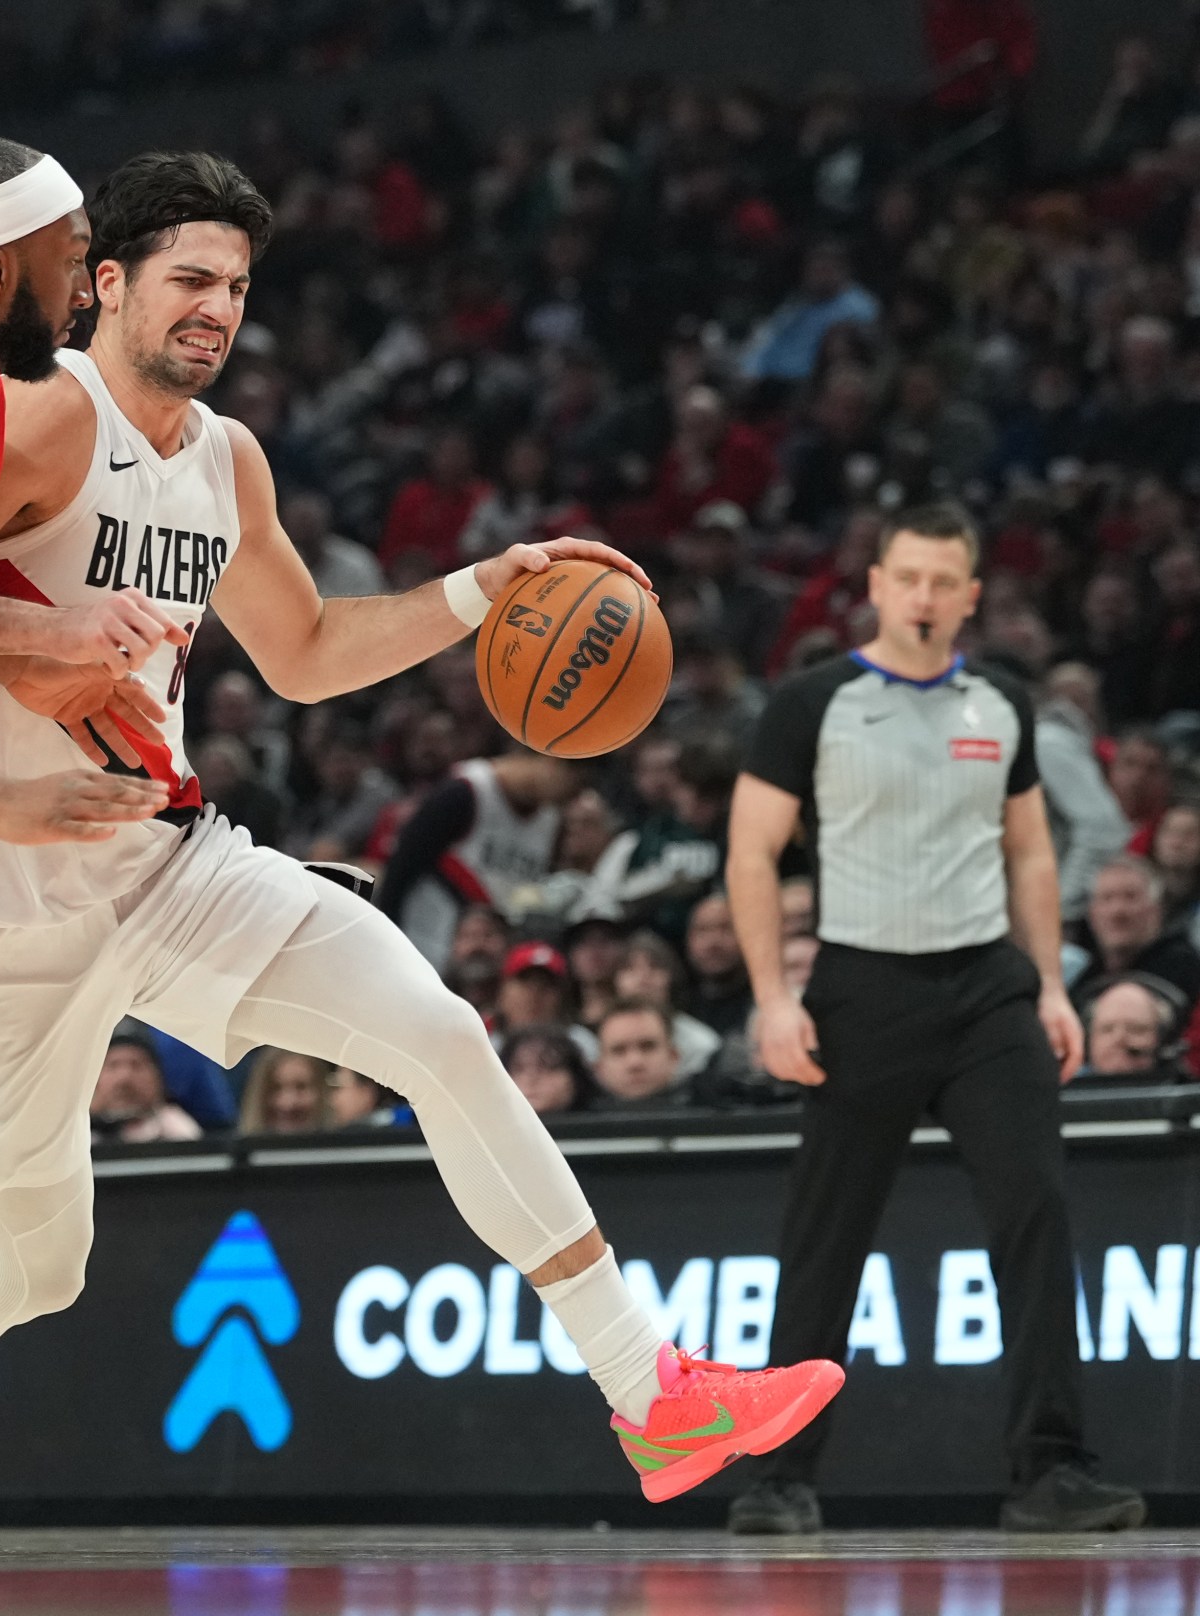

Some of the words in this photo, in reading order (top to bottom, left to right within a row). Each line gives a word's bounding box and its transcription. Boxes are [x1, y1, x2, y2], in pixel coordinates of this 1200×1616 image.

[85, 513, 227, 605] BLAZERS
[542, 595, 633, 711] Wilson
[334, 1252, 905, 1379] COLMBA
